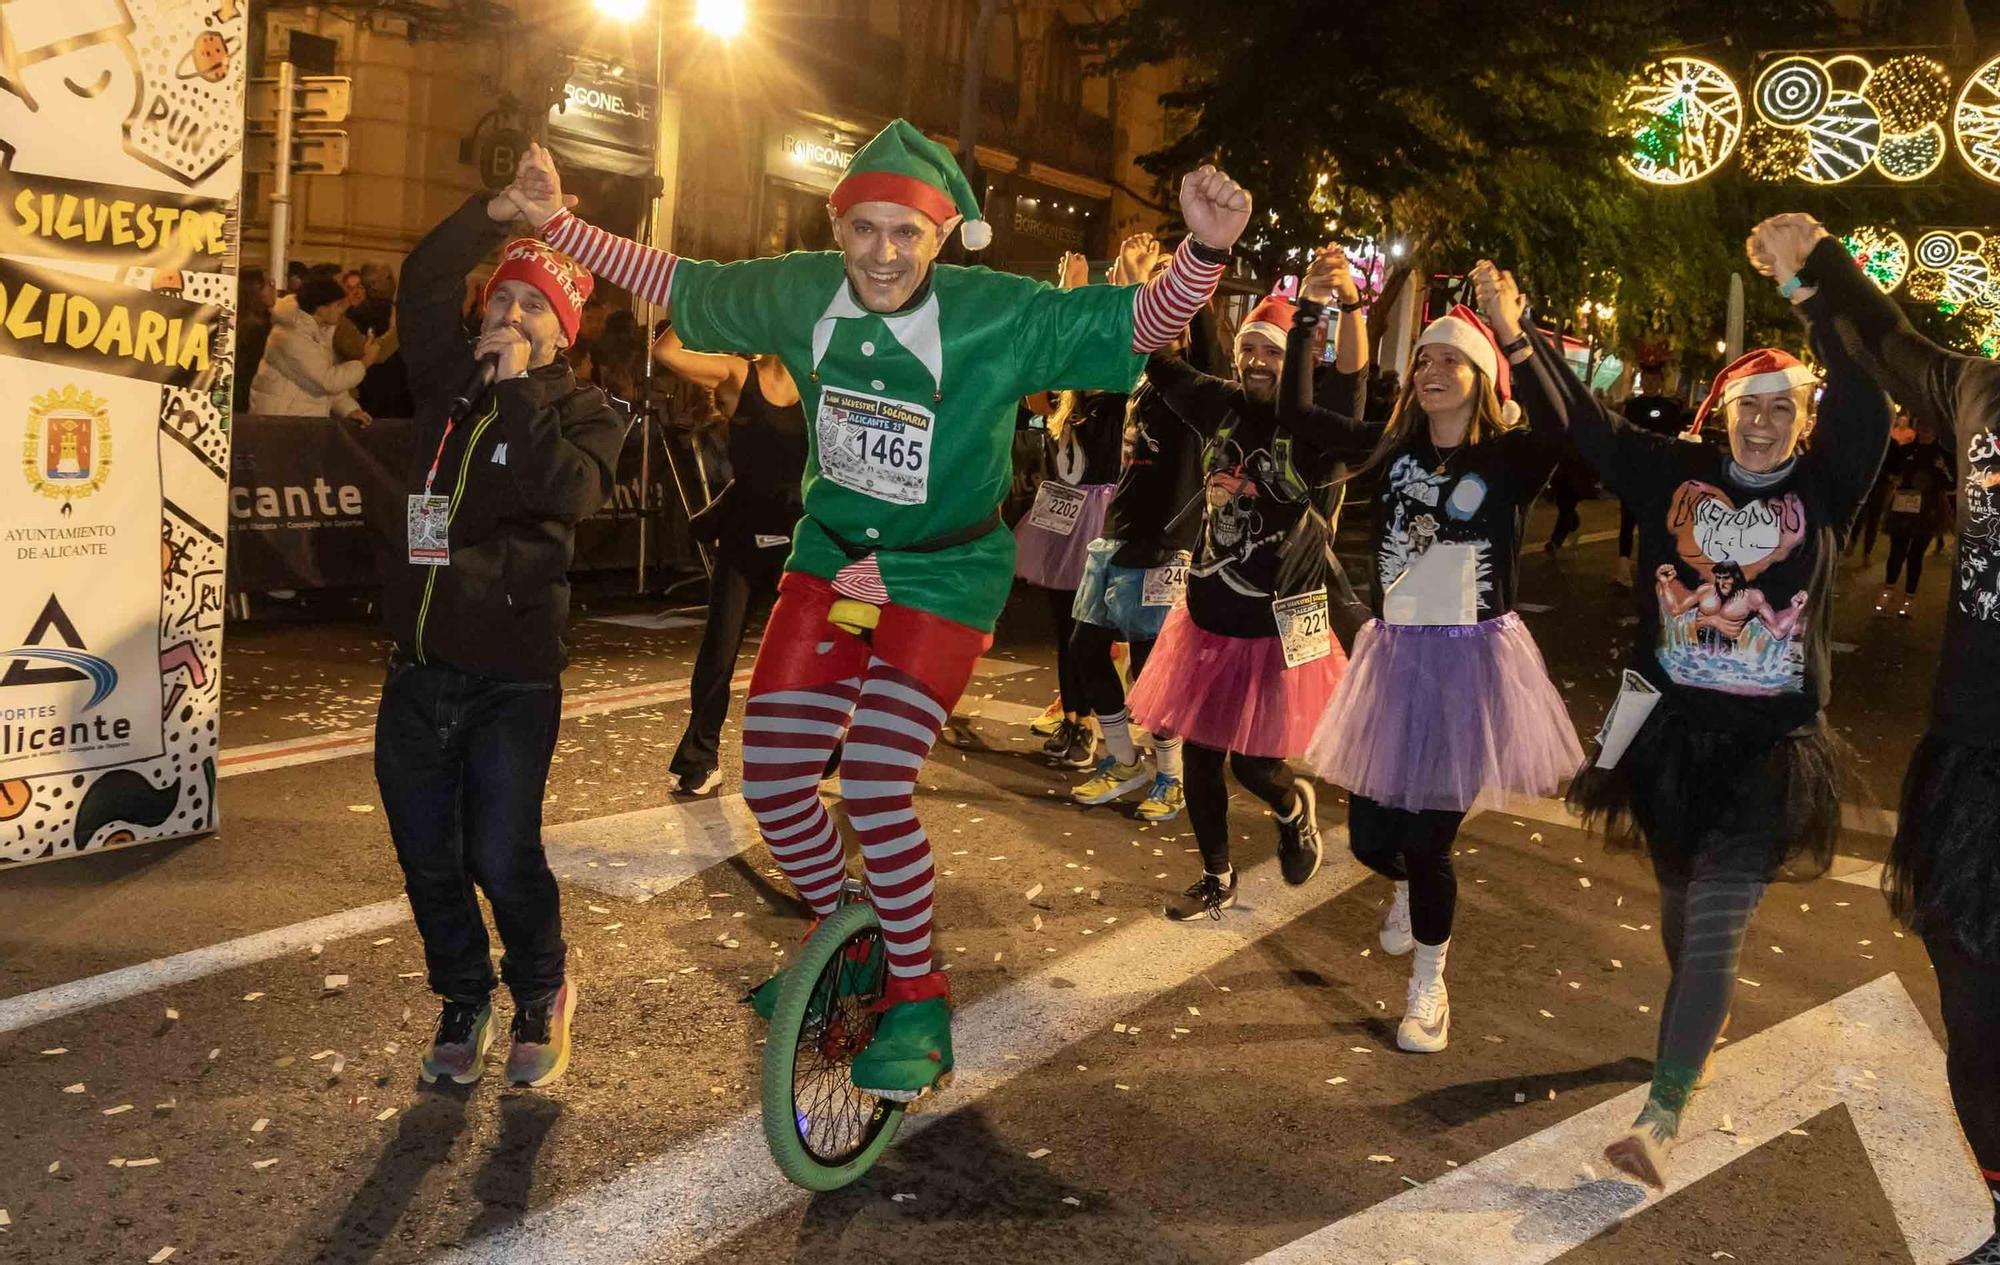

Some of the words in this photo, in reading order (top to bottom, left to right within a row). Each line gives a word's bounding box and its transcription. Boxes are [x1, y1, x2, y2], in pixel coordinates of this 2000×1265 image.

[143, 94, 212, 156] RUN
[15, 188, 228, 255] SILVESTRE
[0, 281, 210, 372] LIDARIA
[848, 414, 890, 430] ALICANTE
[882, 404, 928, 428] SOLIDARIA
[856, 430, 923, 472] 1465
[1050, 498, 1079, 519] 2202
[5, 525, 116, 541] AYUNTAMIENTO
[17, 547, 37, 560] DE
[41, 543, 108, 559] ALICANTE
[0, 705, 56, 721] ORTES
[4, 714, 131, 754] licante
